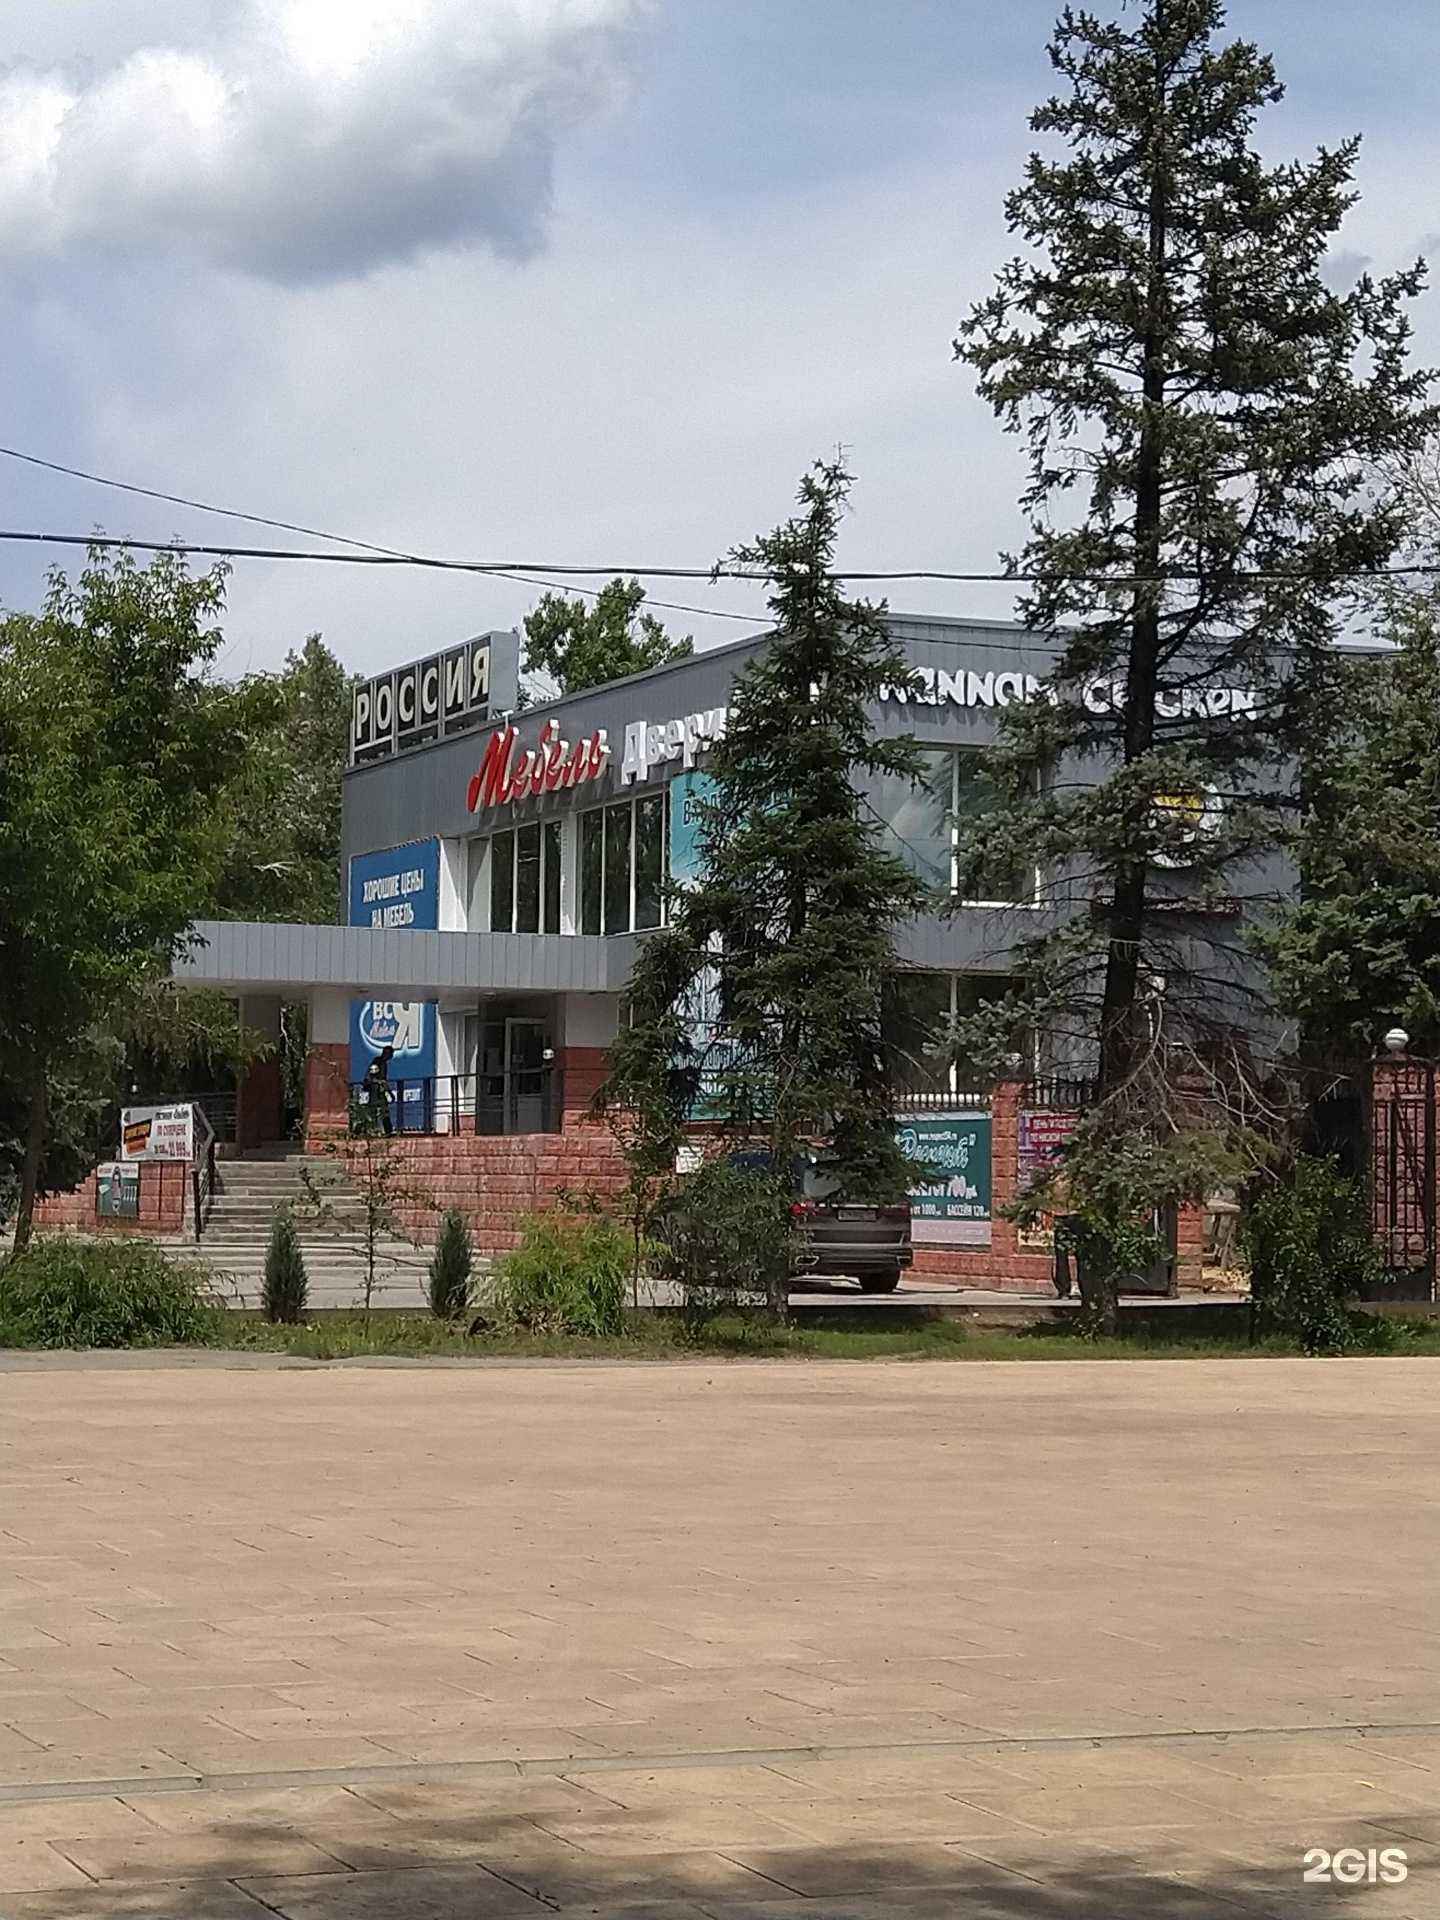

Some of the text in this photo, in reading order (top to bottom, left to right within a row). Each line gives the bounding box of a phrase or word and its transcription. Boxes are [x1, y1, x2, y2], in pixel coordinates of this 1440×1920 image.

[356, 646, 490, 740] РОССИЯ
[466, 707, 728, 814] Мебель Двери
[363, 868, 425, 904] ХОРОШИЕ ЦЕНЫ
[372, 902, 415, 929] НА МЕБЕЛЬ
